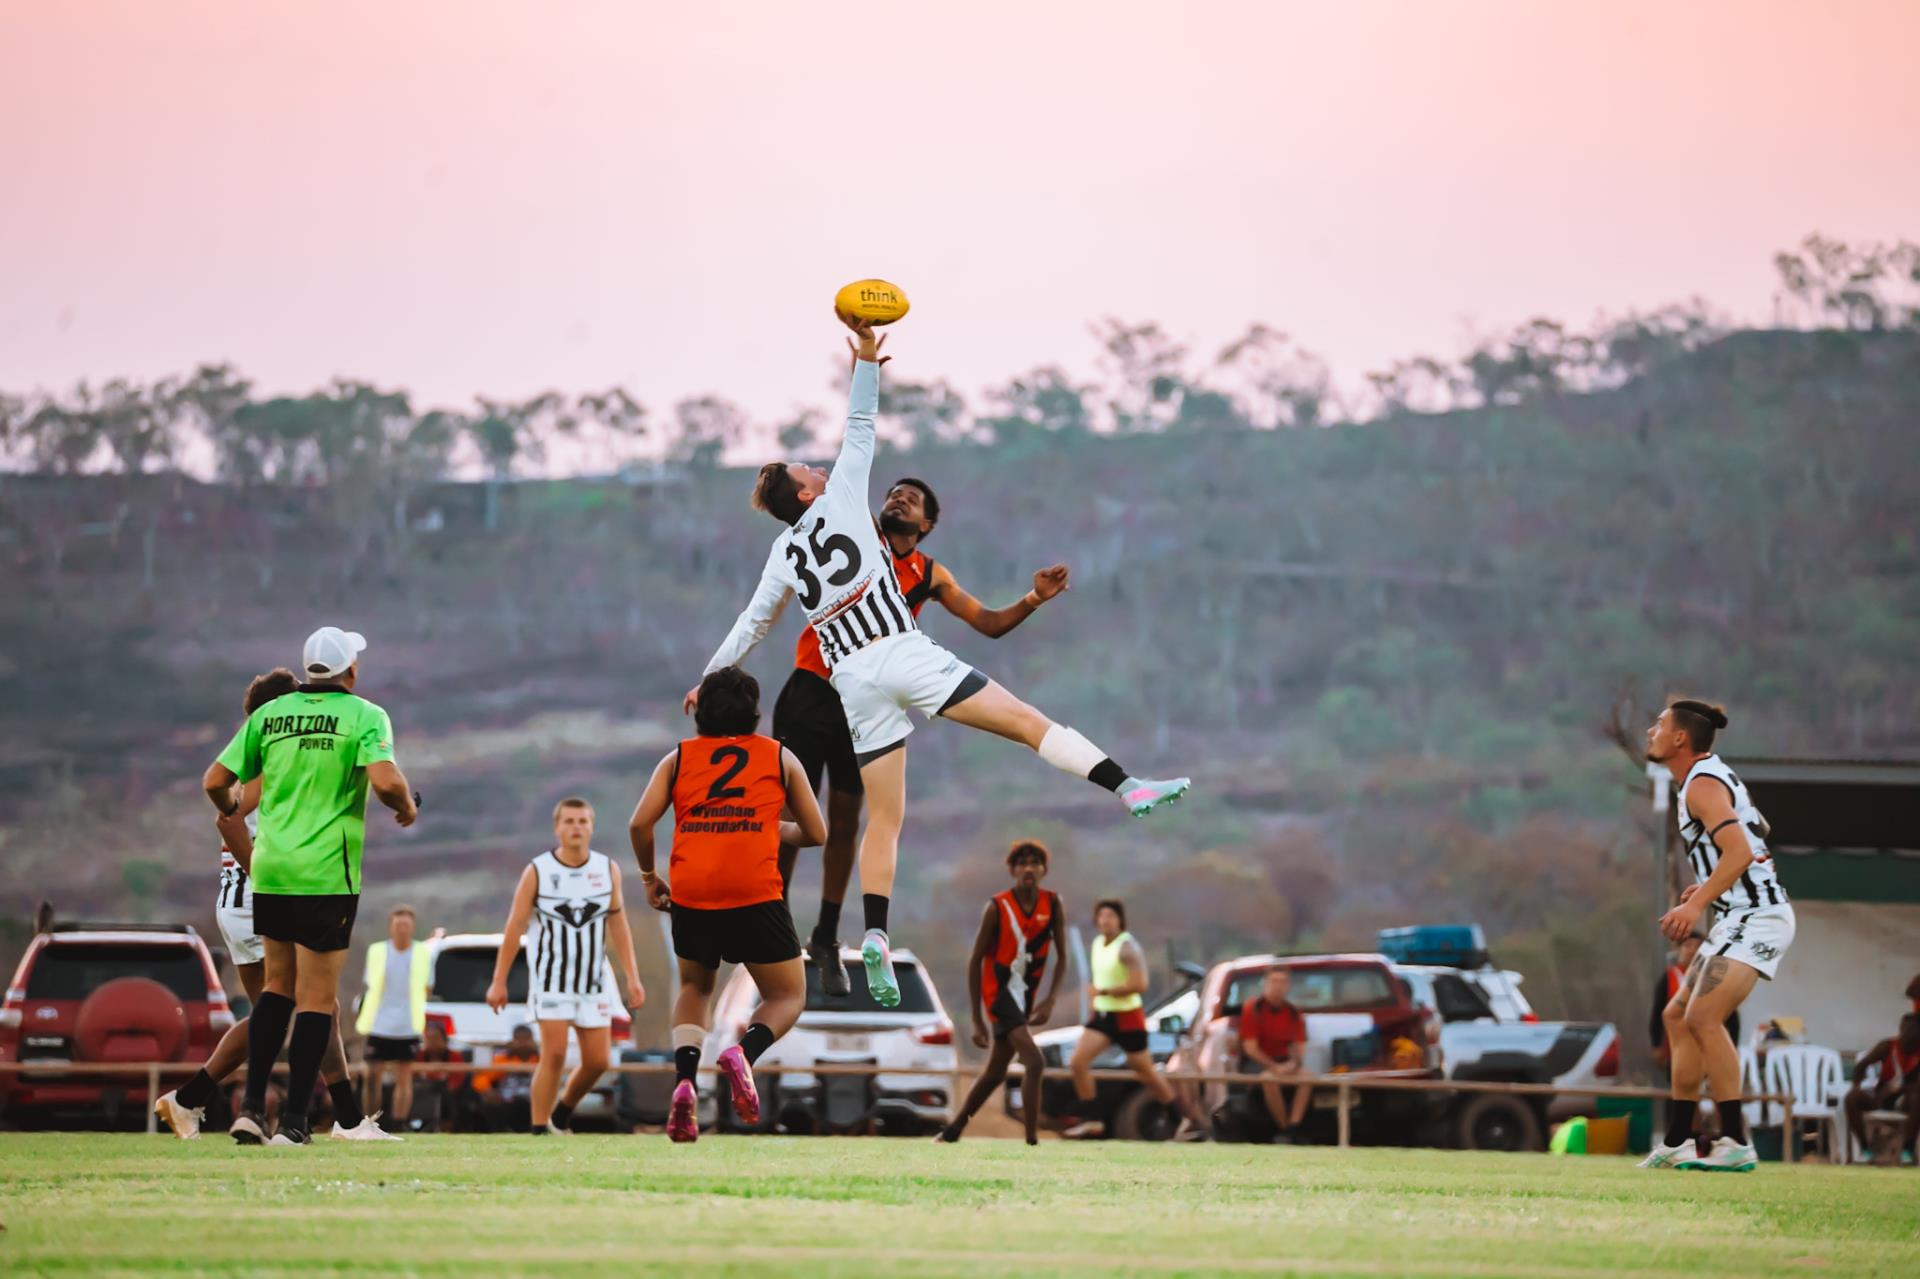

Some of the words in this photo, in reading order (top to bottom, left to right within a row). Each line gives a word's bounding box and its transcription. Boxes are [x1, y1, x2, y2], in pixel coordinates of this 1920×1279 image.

[861, 289, 897, 304] think
[786, 517, 861, 610] 35
[263, 715, 339, 735] HORIZON
[299, 738, 334, 751] POWER
[706, 745, 749, 800] 2
[691, 804, 756, 818] Wyndham
